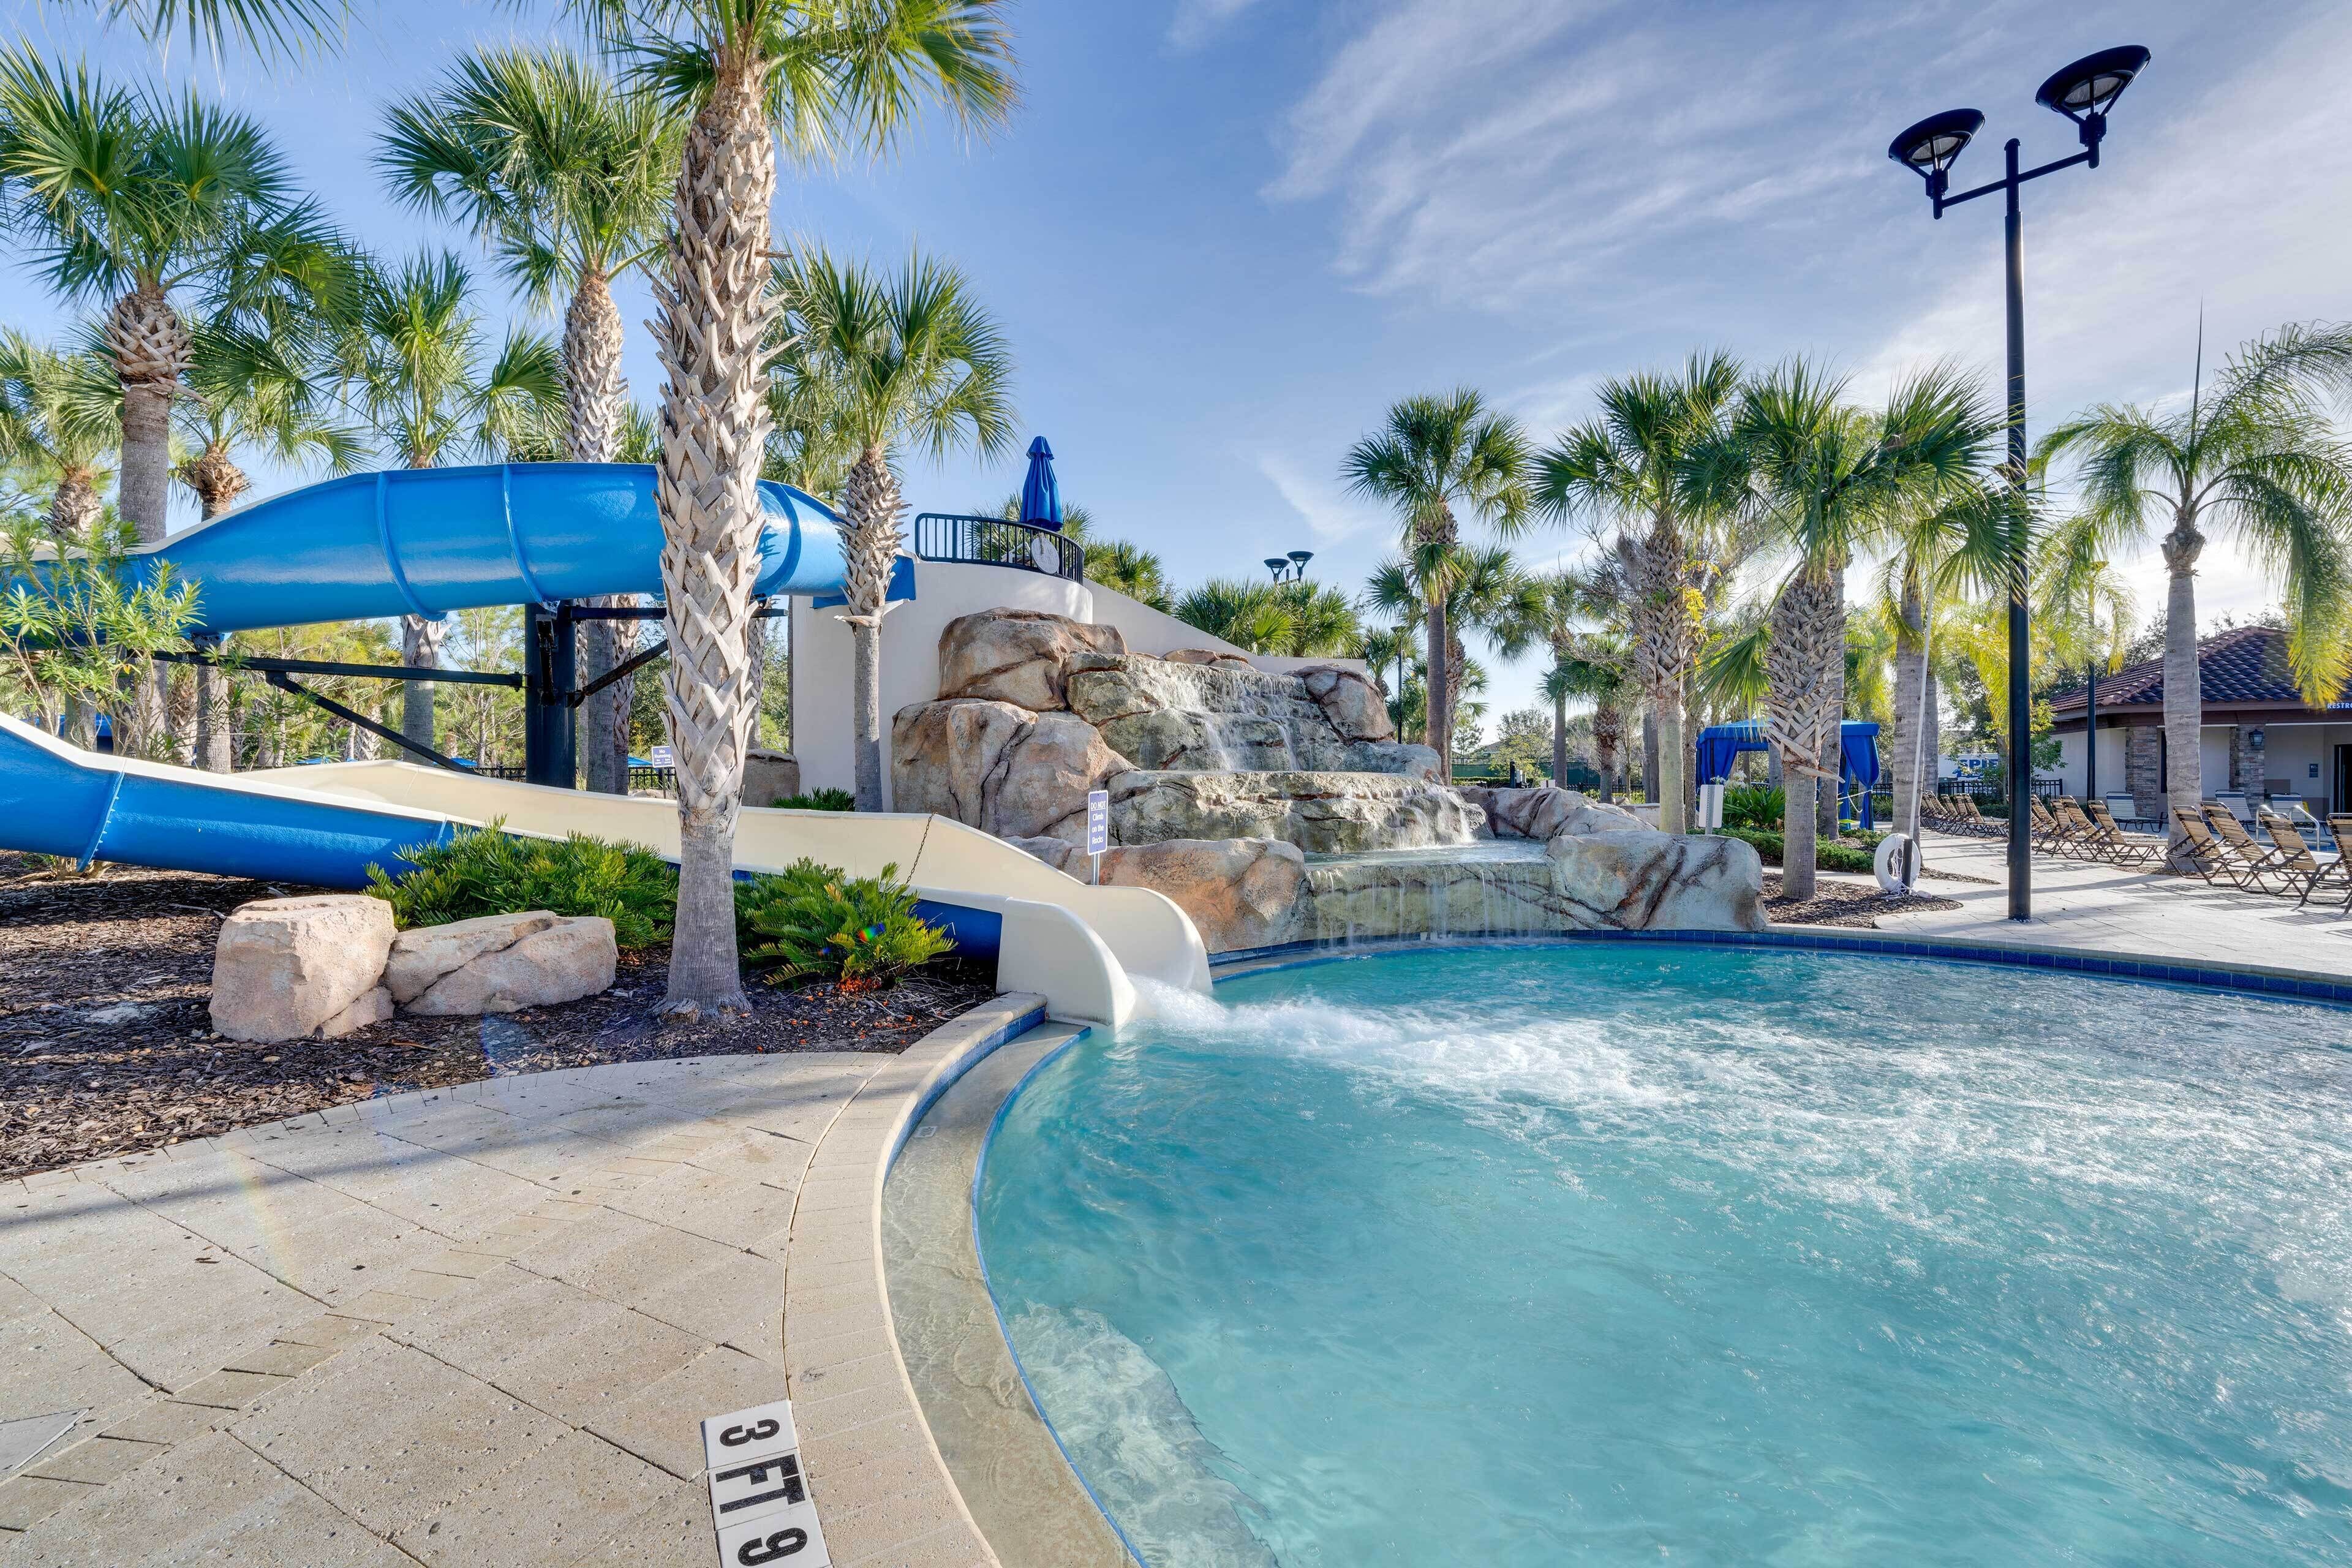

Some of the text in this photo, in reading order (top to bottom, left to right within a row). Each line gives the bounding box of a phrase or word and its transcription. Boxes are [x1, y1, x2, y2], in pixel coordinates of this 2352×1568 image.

[1097, 801, 1106, 809] NOT
[1091, 835, 1104, 845] Rocks
[719, 1419, 780, 1447] 3
[715, 1453, 806, 1515] FT
